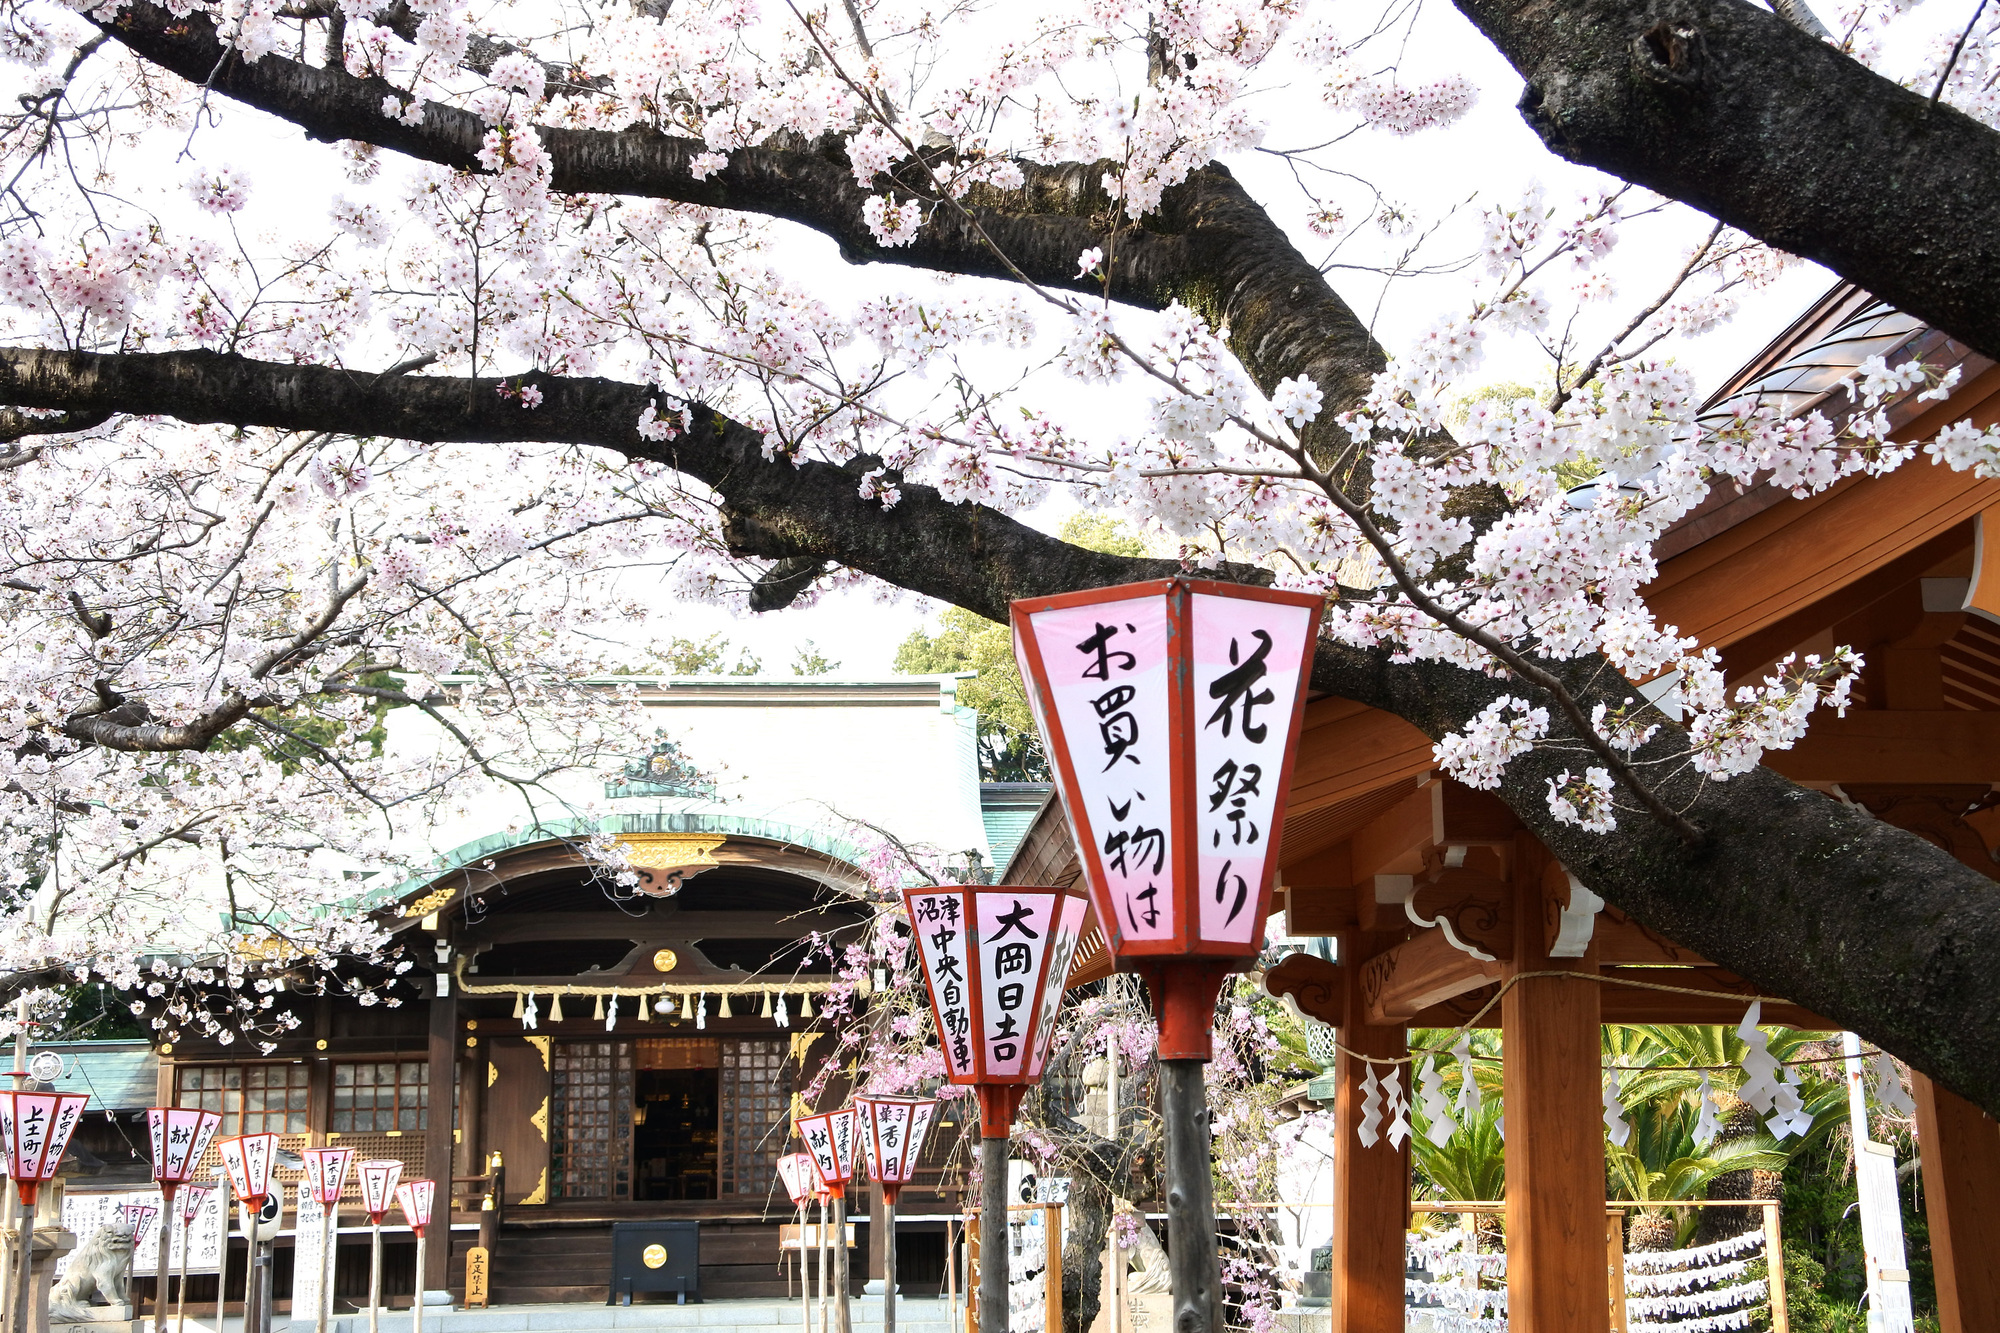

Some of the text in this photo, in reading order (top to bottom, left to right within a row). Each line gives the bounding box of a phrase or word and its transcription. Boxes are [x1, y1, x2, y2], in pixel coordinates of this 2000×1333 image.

[1075, 621, 1165, 934] お買い物は
[1205, 629, 1276, 930] 花祭り
[983, 900, 1039, 1063] 大岡日吉
[23, 1105, 44, 1172] 上土町で
[167, 1125, 193, 1174] 献灯
[810, 1127, 832, 1171] 献灯
[471, 1254, 484, 1296] 土足禁止
